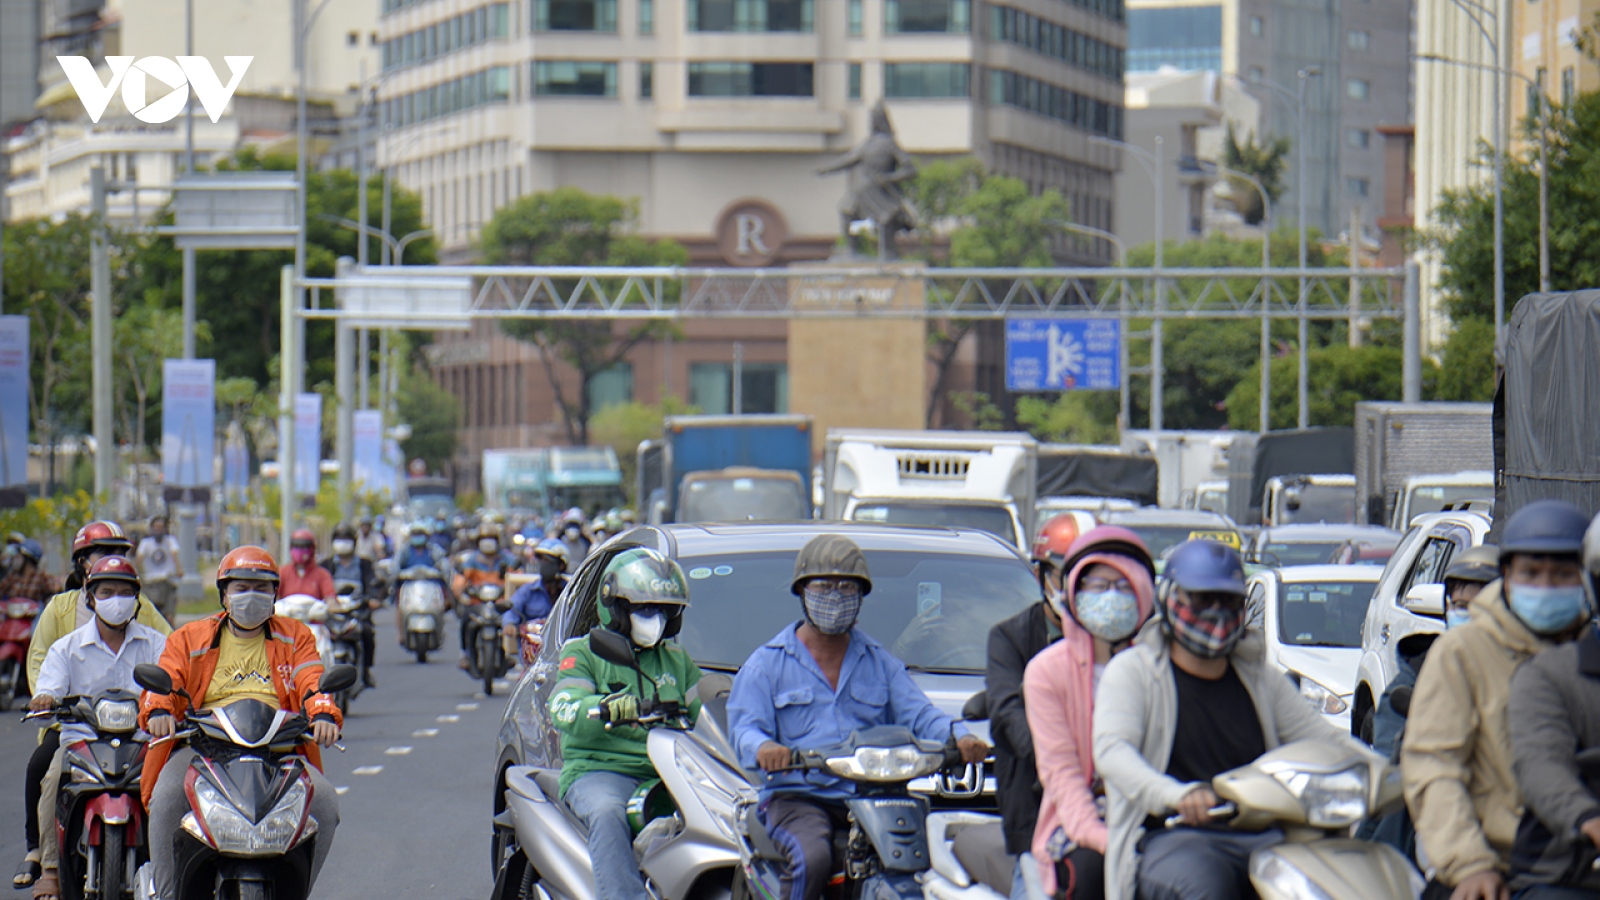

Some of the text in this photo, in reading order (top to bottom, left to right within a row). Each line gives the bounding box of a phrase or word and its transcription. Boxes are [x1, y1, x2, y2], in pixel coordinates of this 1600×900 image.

[735, 213, 770, 256] R
[649, 578, 680, 592] Grab
[874, 799, 917, 808] HONDA
